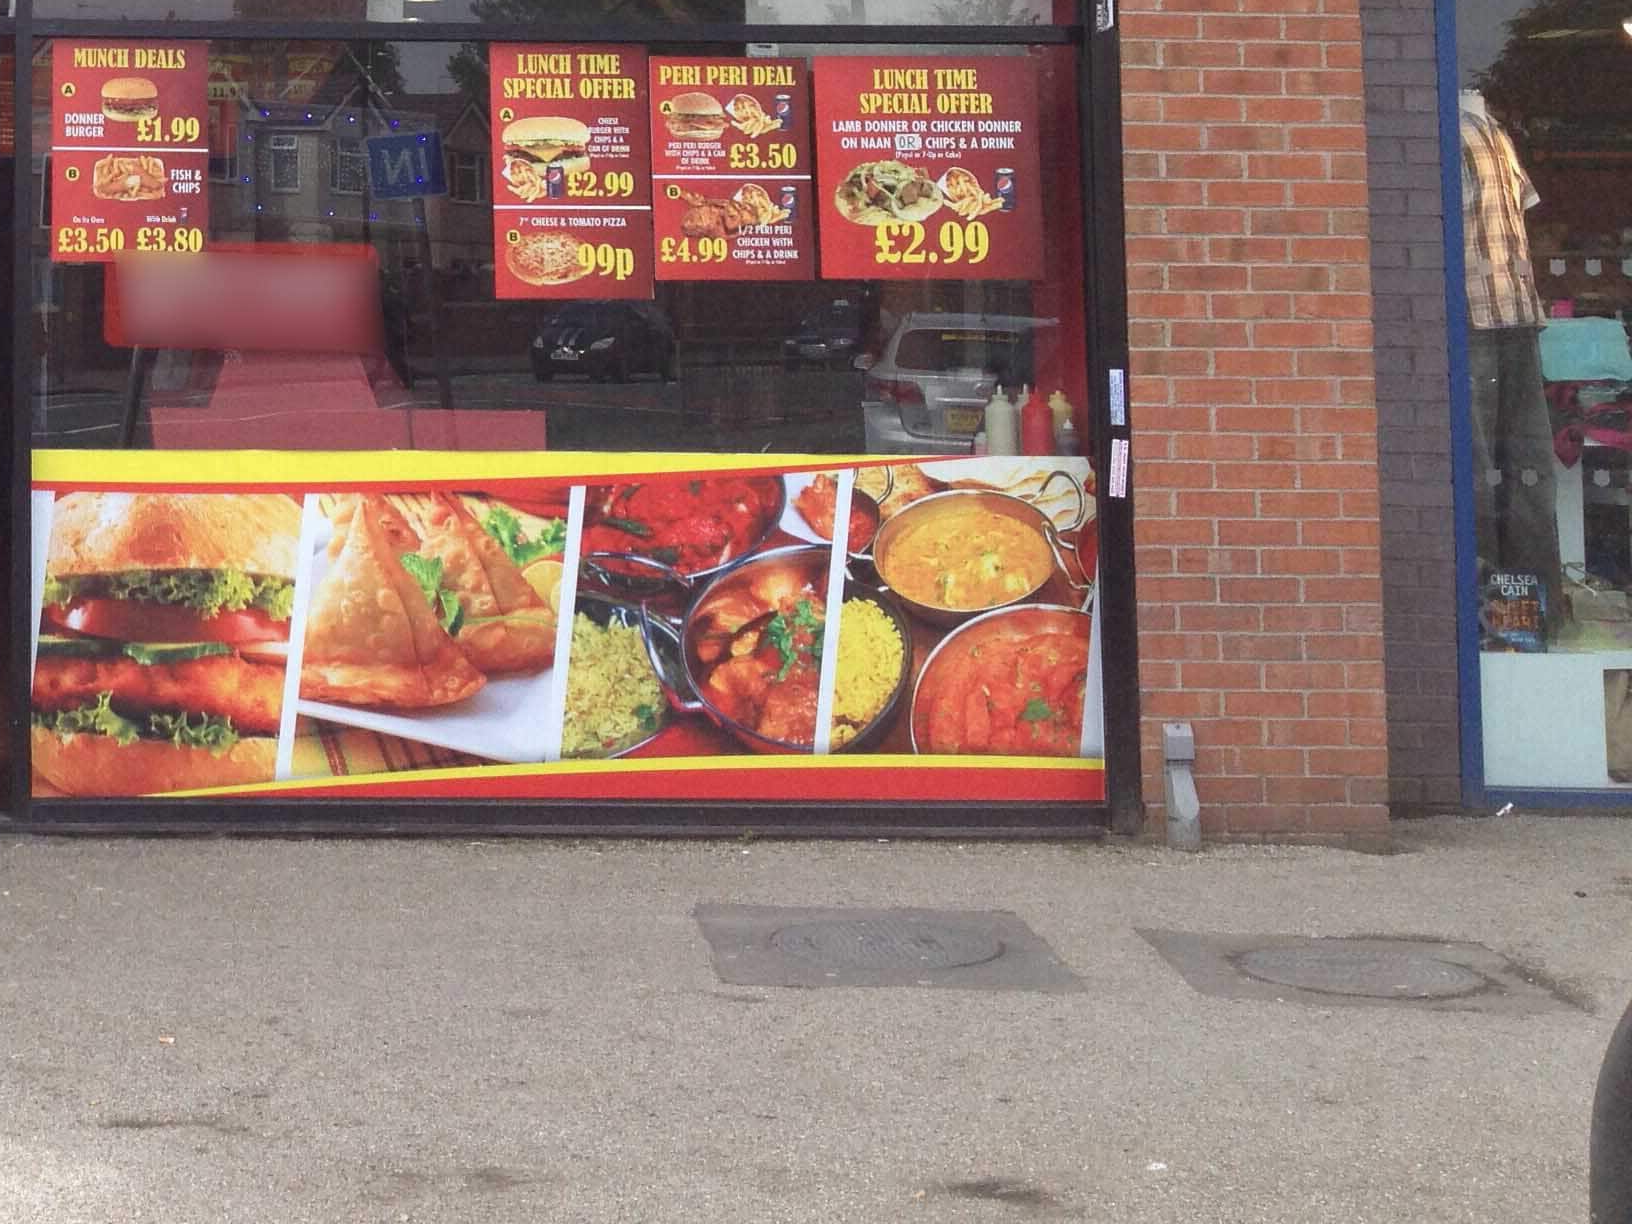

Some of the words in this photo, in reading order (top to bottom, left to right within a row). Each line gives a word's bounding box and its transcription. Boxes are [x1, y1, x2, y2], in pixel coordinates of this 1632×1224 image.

[74, 47, 129, 68] MUNCH
[134, 49, 186, 69] DEALS
[517, 54, 572, 75] LUNCH
[577, 54, 620, 74] TIME
[660, 65, 700, 85] PERI
[707, 66, 747, 86] PERI
[753, 66, 796, 86] DEAL
[873, 69, 928, 90] LUNCH
[934, 69, 977, 90] TIME
[504, 79, 574, 99] SPECIAL
[579, 78, 635, 99] OFFER
[860, 93, 931, 114] SPECIAL
[937, 94, 993, 114] OFFER
[64, 113, 105, 125] DONNER
[136, 117, 200, 142] £1.99
[832, 121, 861, 133] LAMB
[865, 121, 909, 132] DONNER
[911, 121, 927, 132] OR
[930, 121, 975, 133] CHICKEN
[978, 121, 1022, 133] DONNER
[65, 126, 104, 137] BURGER
[841, 137, 858, 149] ON
[861, 137, 891, 149] NAAN
[899, 136, 916, 148] OR
[925, 137, 956, 149] CHIPS
[959, 137, 967, 149] &
[970, 138, 979, 149] A
[981, 138, 1015, 149] DRINK
[730, 144, 797, 168] £3.50
[170, 169, 193, 181] FISH
[194, 170, 202, 181] &
[567, 171, 634, 197] £2.99
[172, 182, 201, 194] CHIPS
[531, 217, 558, 226] CHEESE
[559, 217, 567, 226] &
[568, 217, 601, 227] TOMATO
[602, 217, 627, 227] PIZZA
[58, 227, 125, 253] £3.50
[136, 227, 203, 253] £3.80
[661, 237, 727, 263] £4.99
[737, 237, 770, 247] CHICKEN
[771, 237, 793, 247] WITH
[875, 221, 989, 264] £2.99
[578, 243, 634, 280] 99p
[732, 249, 756, 259] CHIPS
[773, 250, 799, 259] DRINK
[1490, 575, 1538, 585] CHELSEA
[1501, 585, 1529, 596] CAIN
